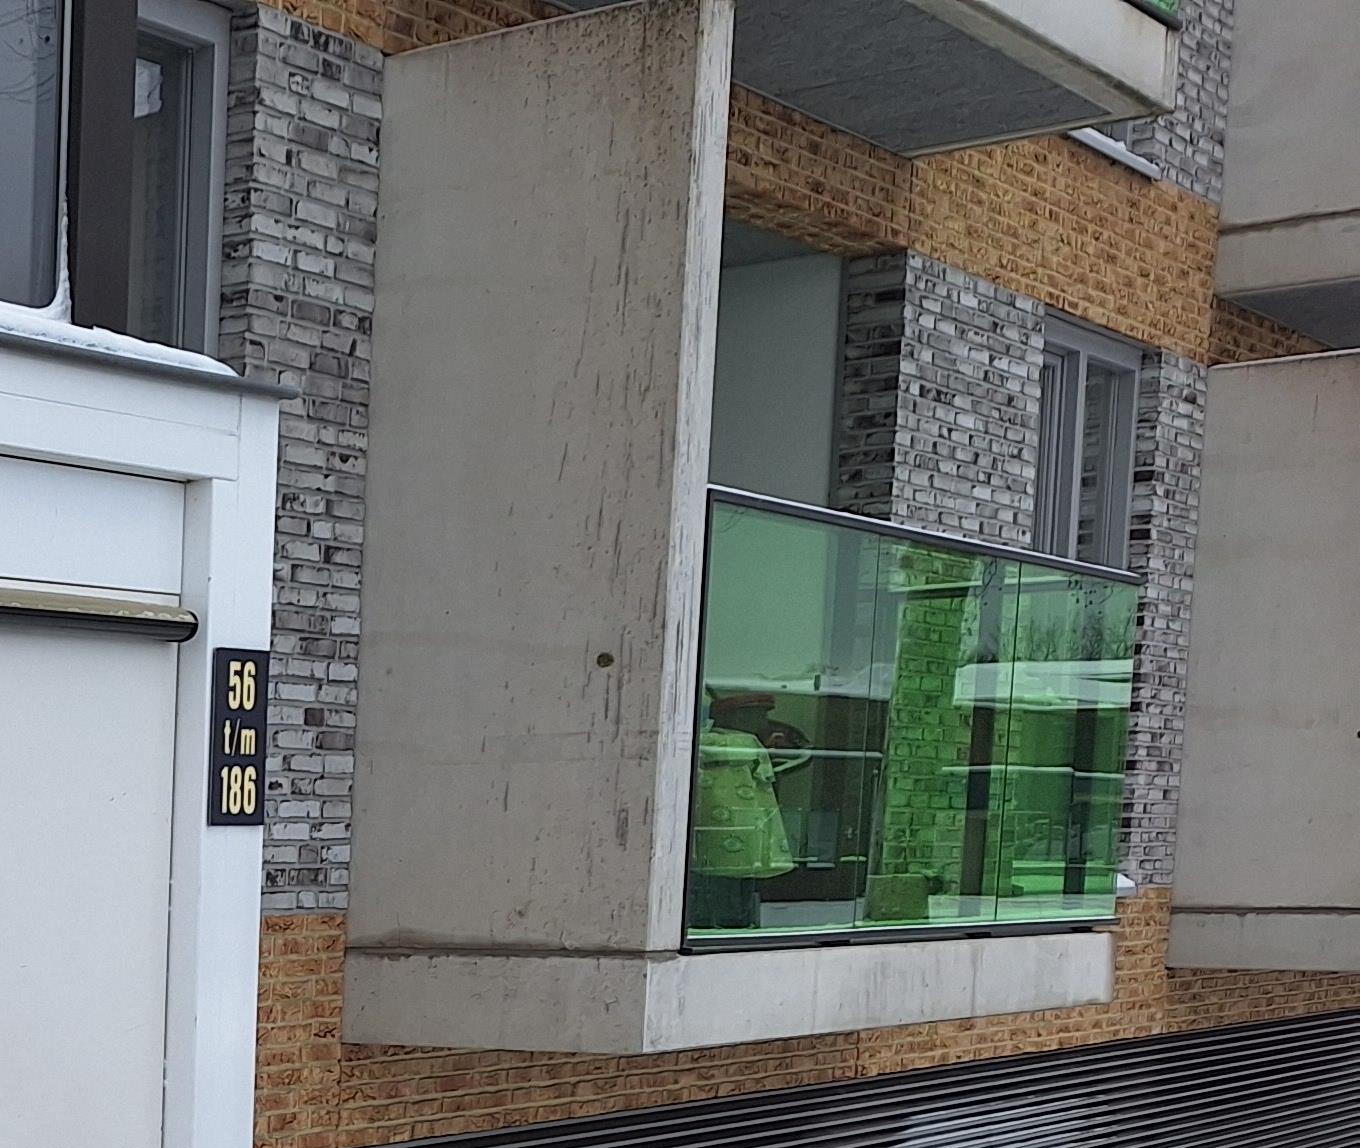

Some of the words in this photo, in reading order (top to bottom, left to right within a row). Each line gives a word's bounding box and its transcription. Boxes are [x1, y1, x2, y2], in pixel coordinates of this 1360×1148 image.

[228, 661, 256, 711] 56
[224, 718, 256, 756] t/m
[221, 765, 256, 814] 186
